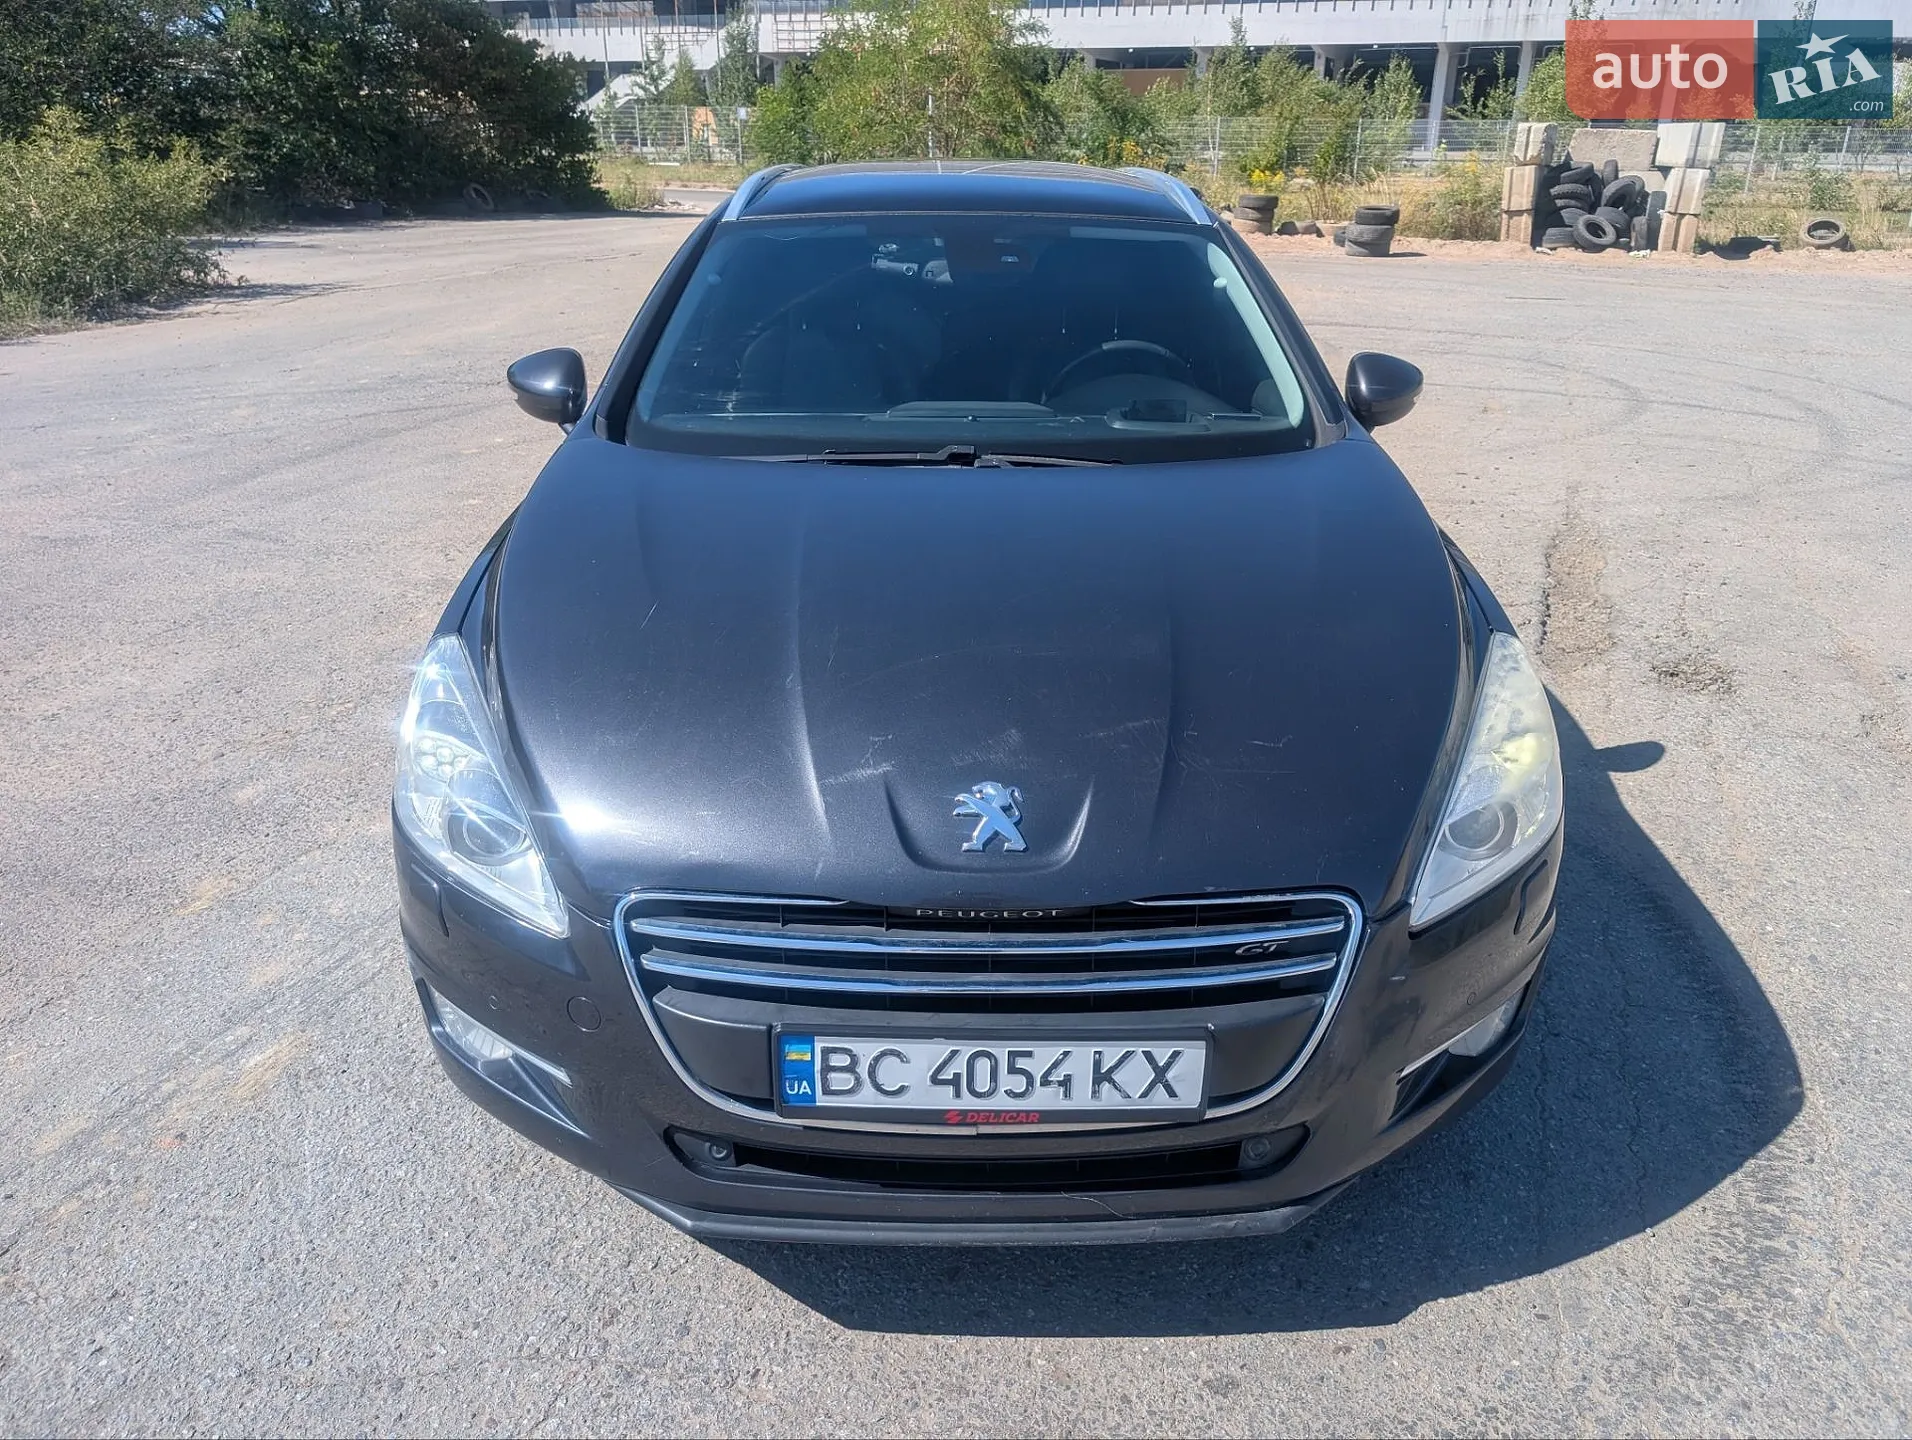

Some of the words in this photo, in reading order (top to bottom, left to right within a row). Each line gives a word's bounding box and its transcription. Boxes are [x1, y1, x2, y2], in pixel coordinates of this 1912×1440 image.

[916, 909, 1062, 918] PEUGEOT
[1235, 940, 1289, 955] GT
[819, 1045, 911, 1097] BC
[928, 1048, 1074, 1101] 4054
[1090, 1048, 1186, 1101] KX
[785, 1078, 812, 1096] UA
[965, 1111, 1041, 1123] DELICAR
